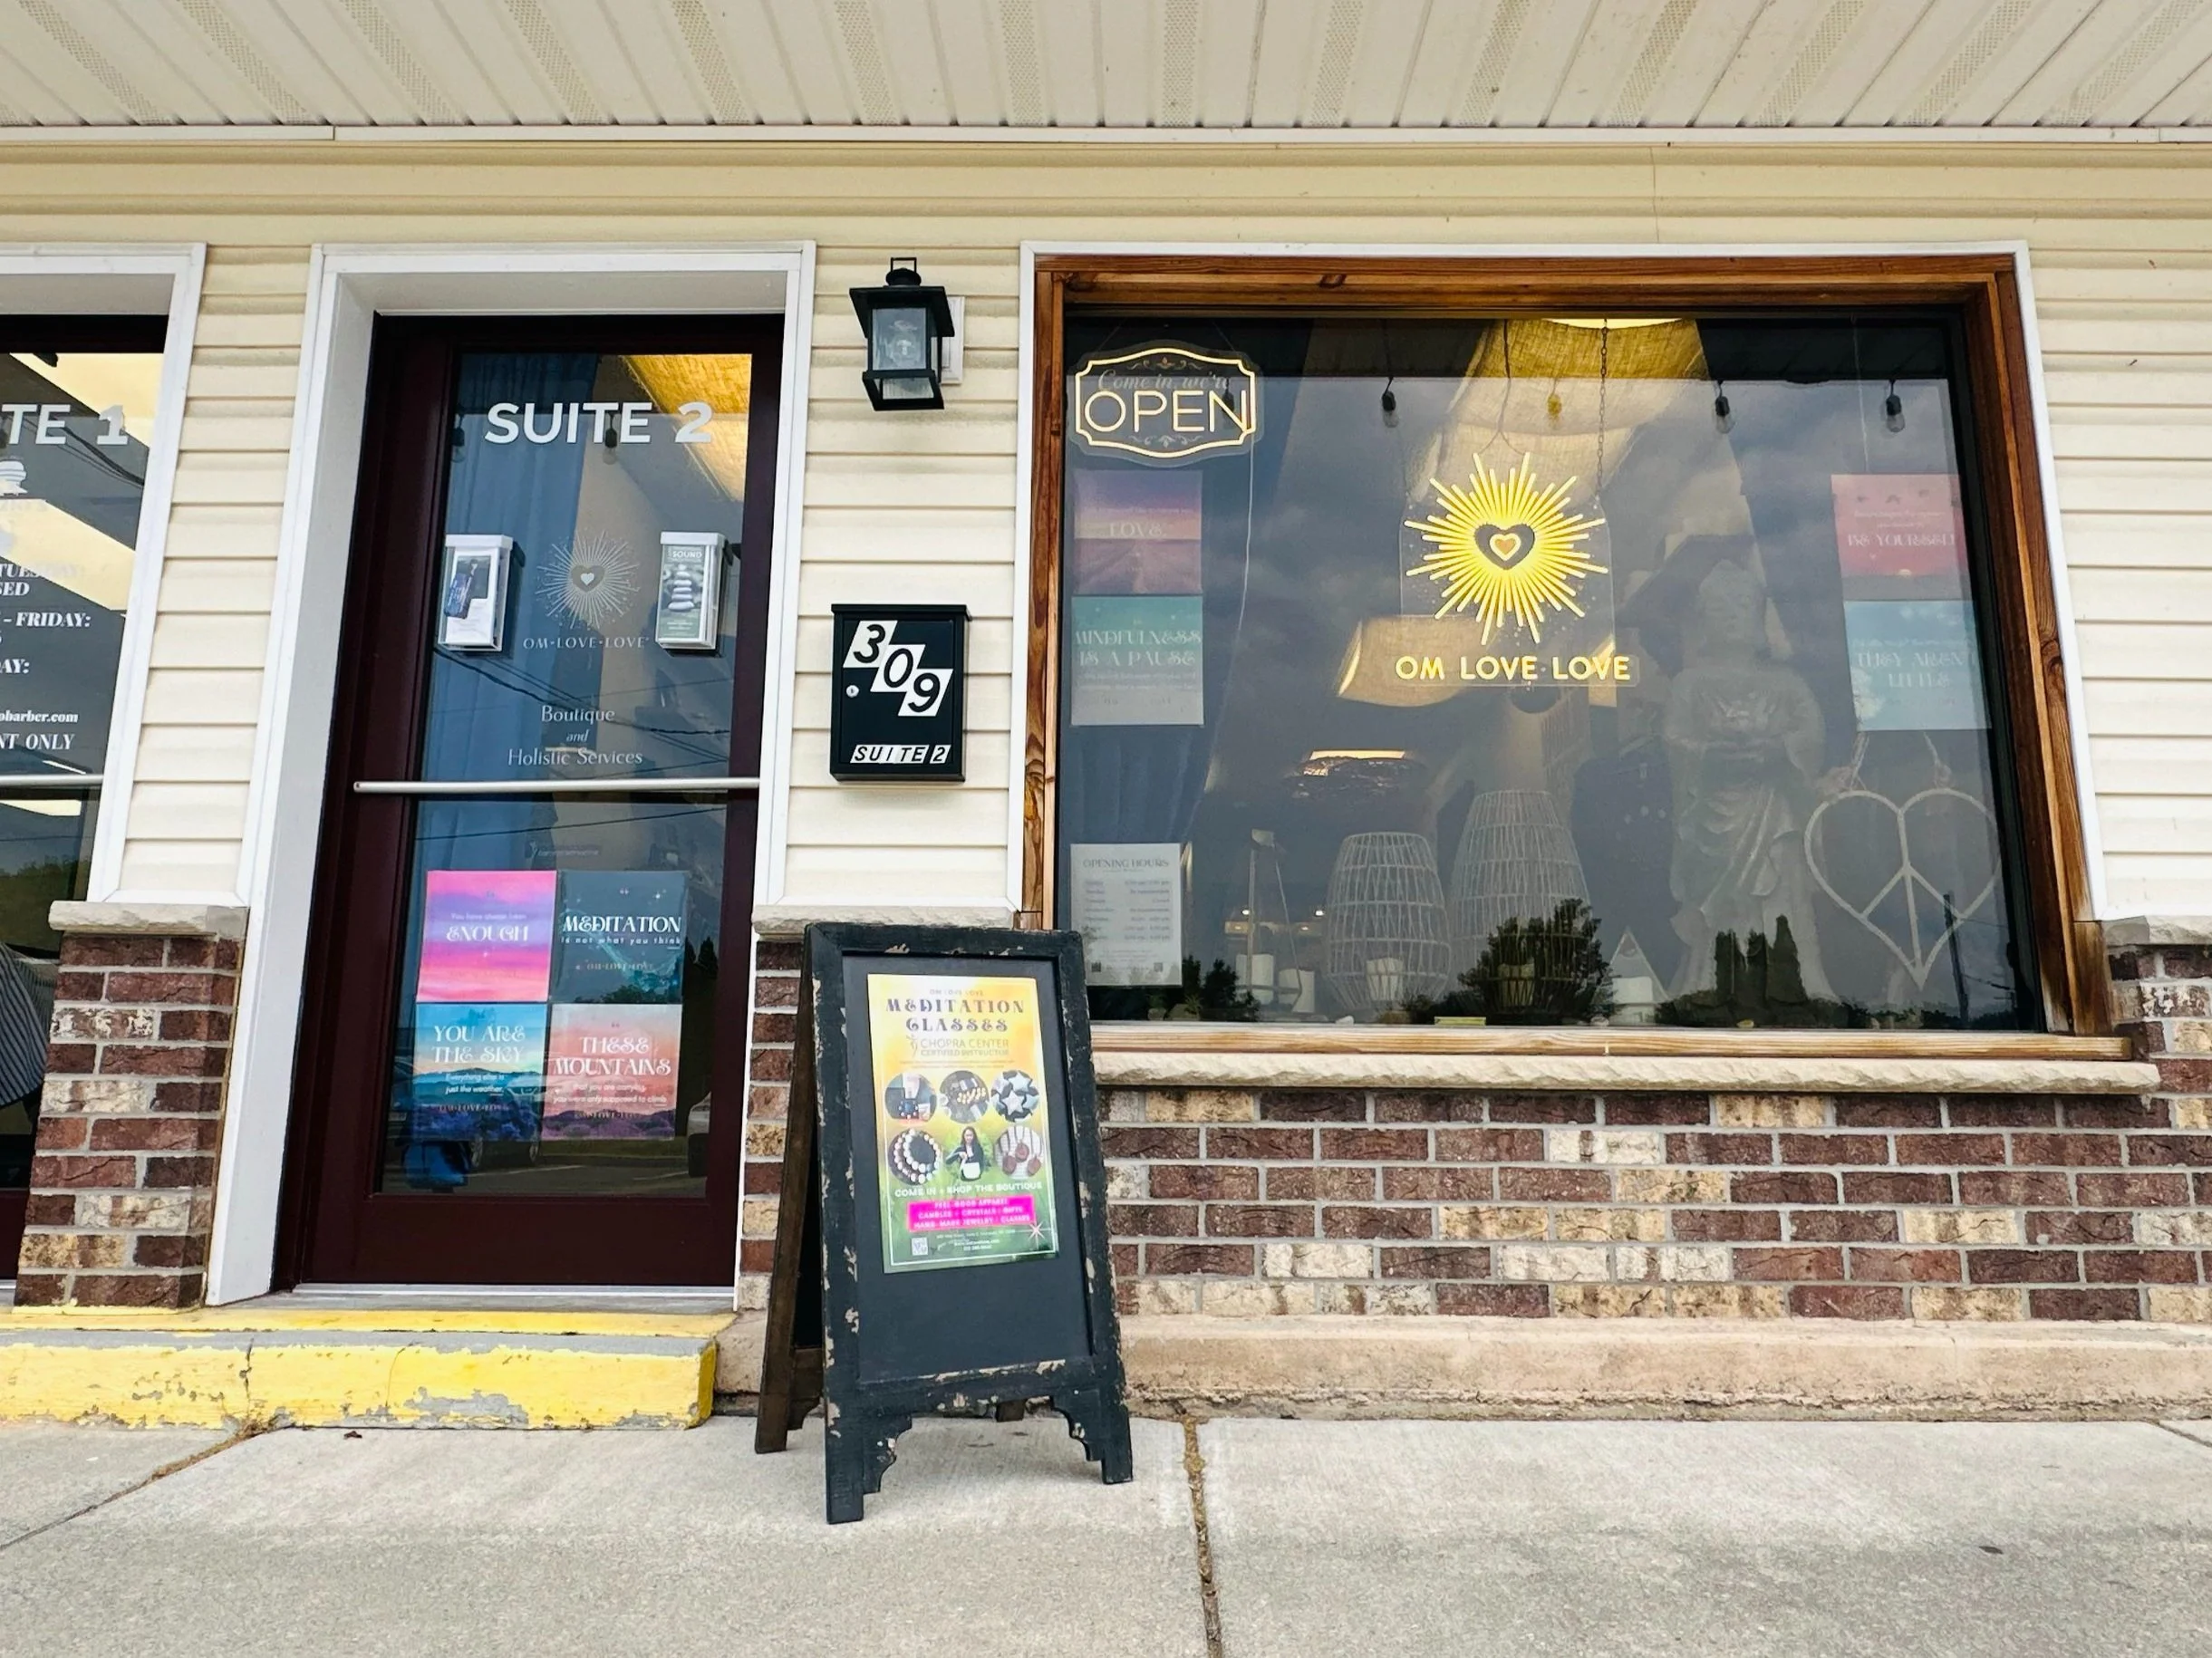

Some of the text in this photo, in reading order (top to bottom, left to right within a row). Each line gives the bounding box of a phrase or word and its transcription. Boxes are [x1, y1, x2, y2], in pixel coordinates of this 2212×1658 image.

[1098, 370, 1150, 390] Come
[1183, 371, 1229, 390] we're
[1085, 390, 1247, 432] OPEN
[97, 405, 128, 445] 1
[485, 401, 713, 444] SUITE 2
[672, 550, 702, 560] SOUND
[0, 582, 30, 596] ED
[15, 612, 91, 627] FRIDAY:
[0, 659, 30, 674] AY:
[1108, 651, 1121, 667] A
[854, 624, 941, 713] 309
[1396, 656, 1630, 680] OM LOVE LOVE
[541, 705, 615, 724] Boutique
[25, 733, 75, 750] ONLY
[566, 729, 589, 742] and
[507, 747, 642, 766] Holistic Services
[855, 747, 946, 762] SUITE 2
[1083, 858, 1169, 870] OPENING HOURS
[563, 915, 681, 933] MEDITATION
[446, 925, 529, 942] ENOUGH
[630, 938, 649, 946] you
[886, 998, 1024, 1013] MEDITATION
[906, 1017, 1008, 1032] CLASSES
[434, 1025, 526, 1043] YOU ARE
[581, 1036, 649, 1054] THESE
[921, 1038, 1009, 1049] CHOPRA CENTER
[431, 1046, 525, 1063] THE SKY
[554, 1058, 671, 1075] MOUNTAINS
[894, 1181, 1042, 1197] COME IN SHOP THE BOUTIQUE
